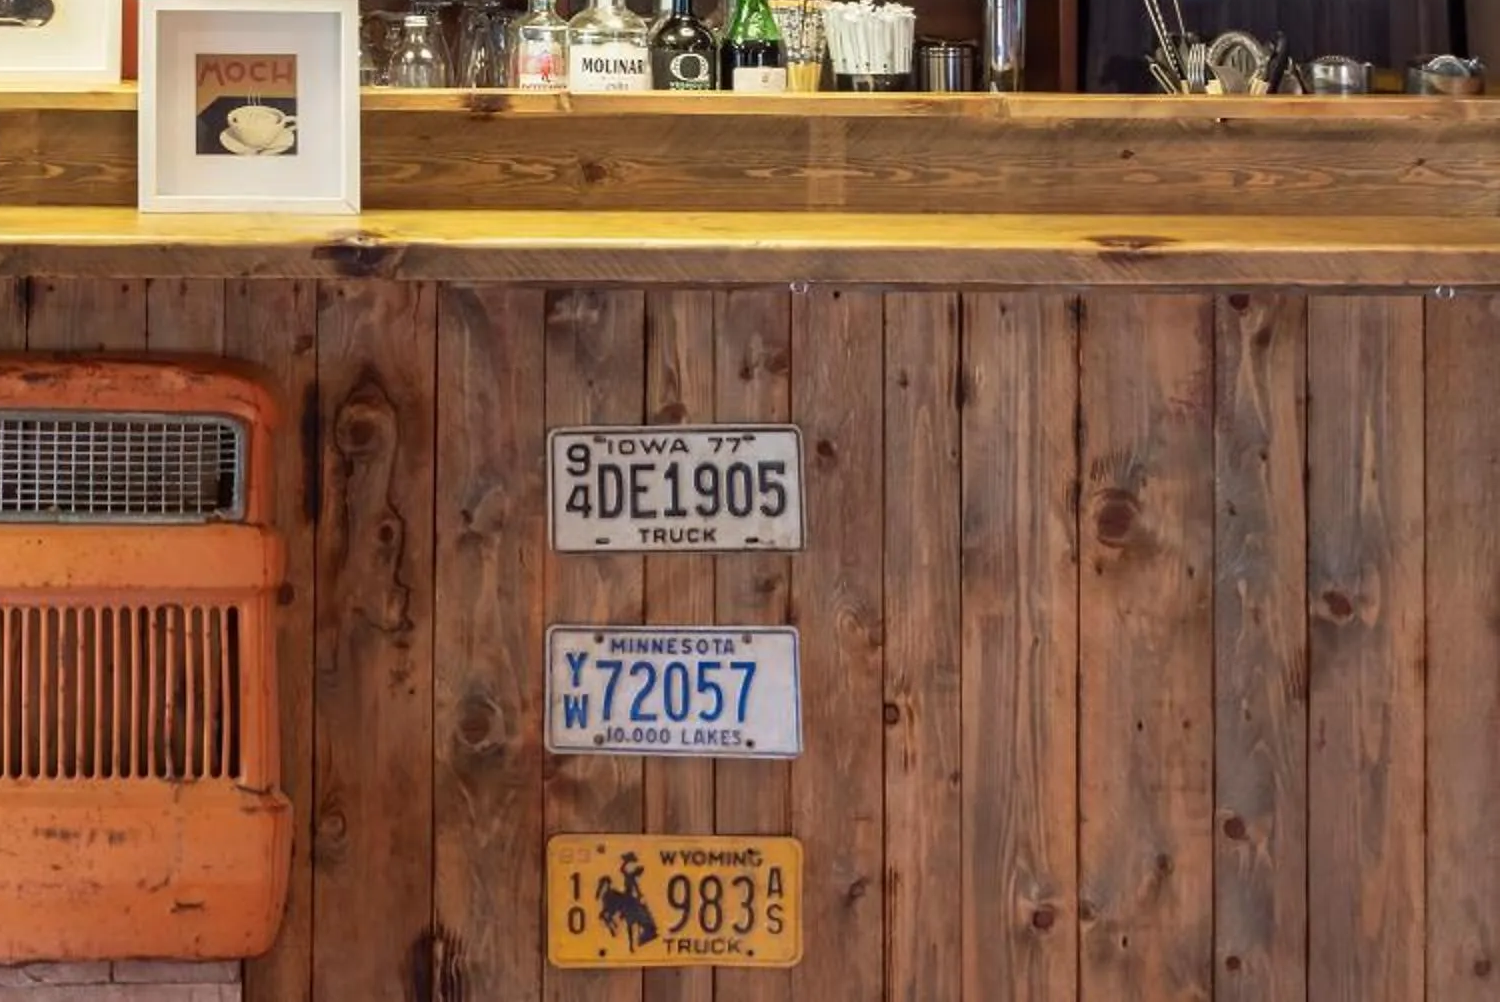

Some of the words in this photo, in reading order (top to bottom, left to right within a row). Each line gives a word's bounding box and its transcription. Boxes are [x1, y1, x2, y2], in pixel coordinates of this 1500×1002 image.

[197, 59, 293, 87] MOCH
[606, 438, 690, 455] IOWA
[708, 436, 744, 454] 77
[597, 461, 787, 520] DE1905
[639, 527, 718, 545] TRUCK
[610, 638, 736, 655] MINNESOTA
[596, 660, 757, 723] 72057
[681, 729, 743, 746] LAKES
[660, 849, 764, 868] WYOMING
[667, 873, 756, 936] 983
[662, 938, 741, 956] TRUCK
